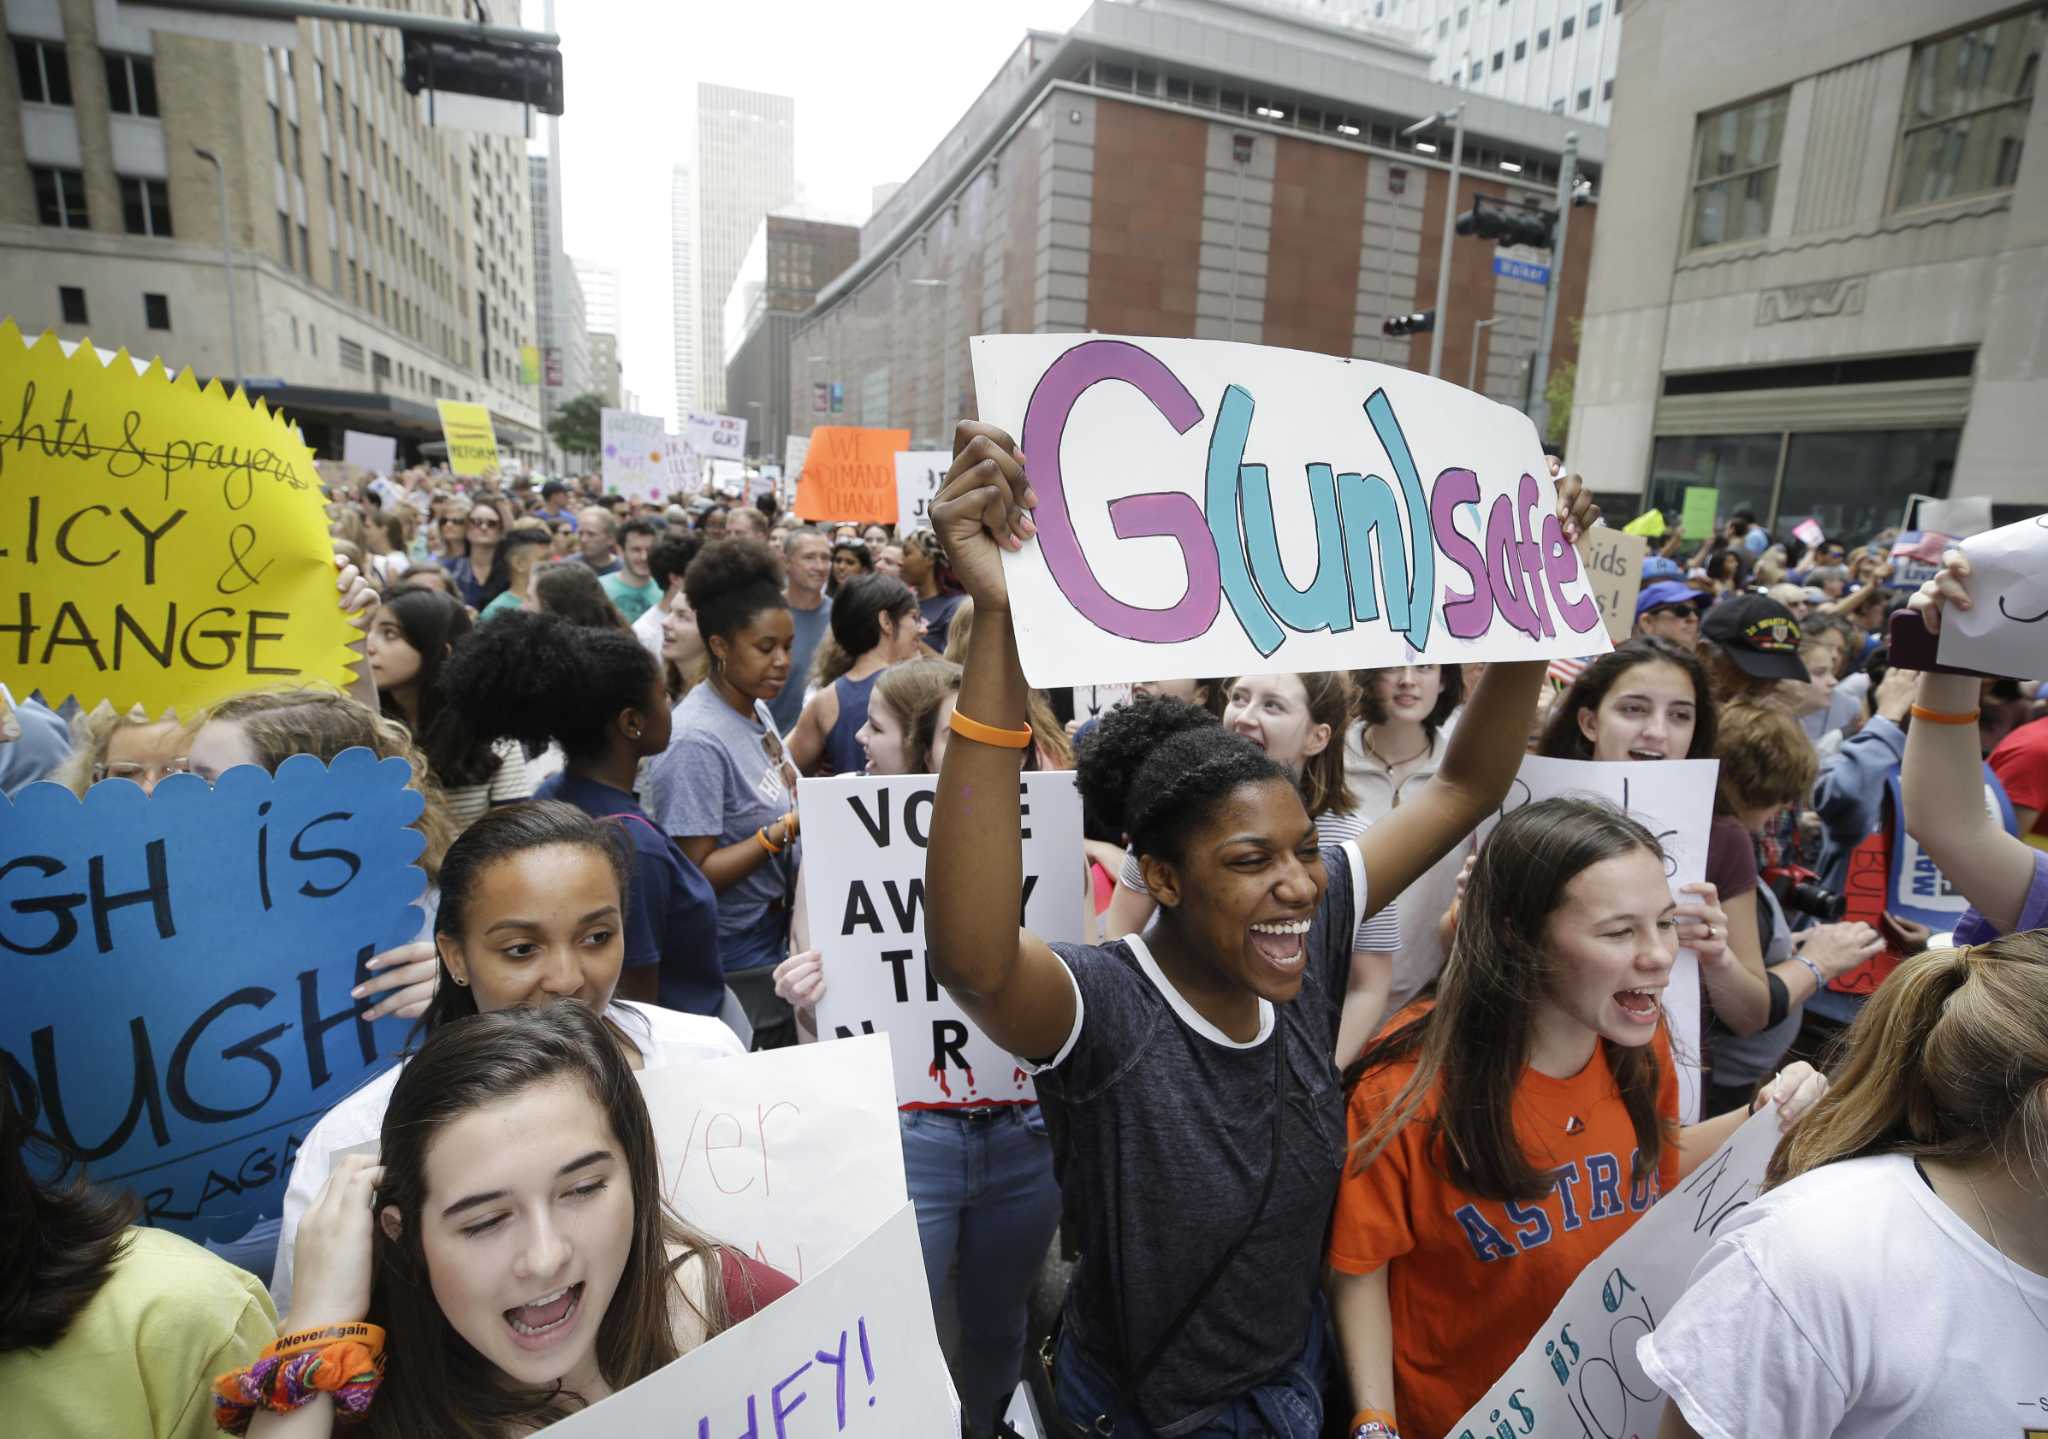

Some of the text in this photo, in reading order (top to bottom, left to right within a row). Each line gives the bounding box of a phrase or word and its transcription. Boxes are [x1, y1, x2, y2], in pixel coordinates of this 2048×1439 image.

[106, 410, 155, 478] &
[161, 438, 309, 511] prayers
[827, 431, 864, 462] WE
[0, 496, 275, 595] ICY &
[1584, 542, 1628, 577] ids
[274, 1324, 368, 1351] #NeverAgain
[1545, 1323, 1580, 1386] is
